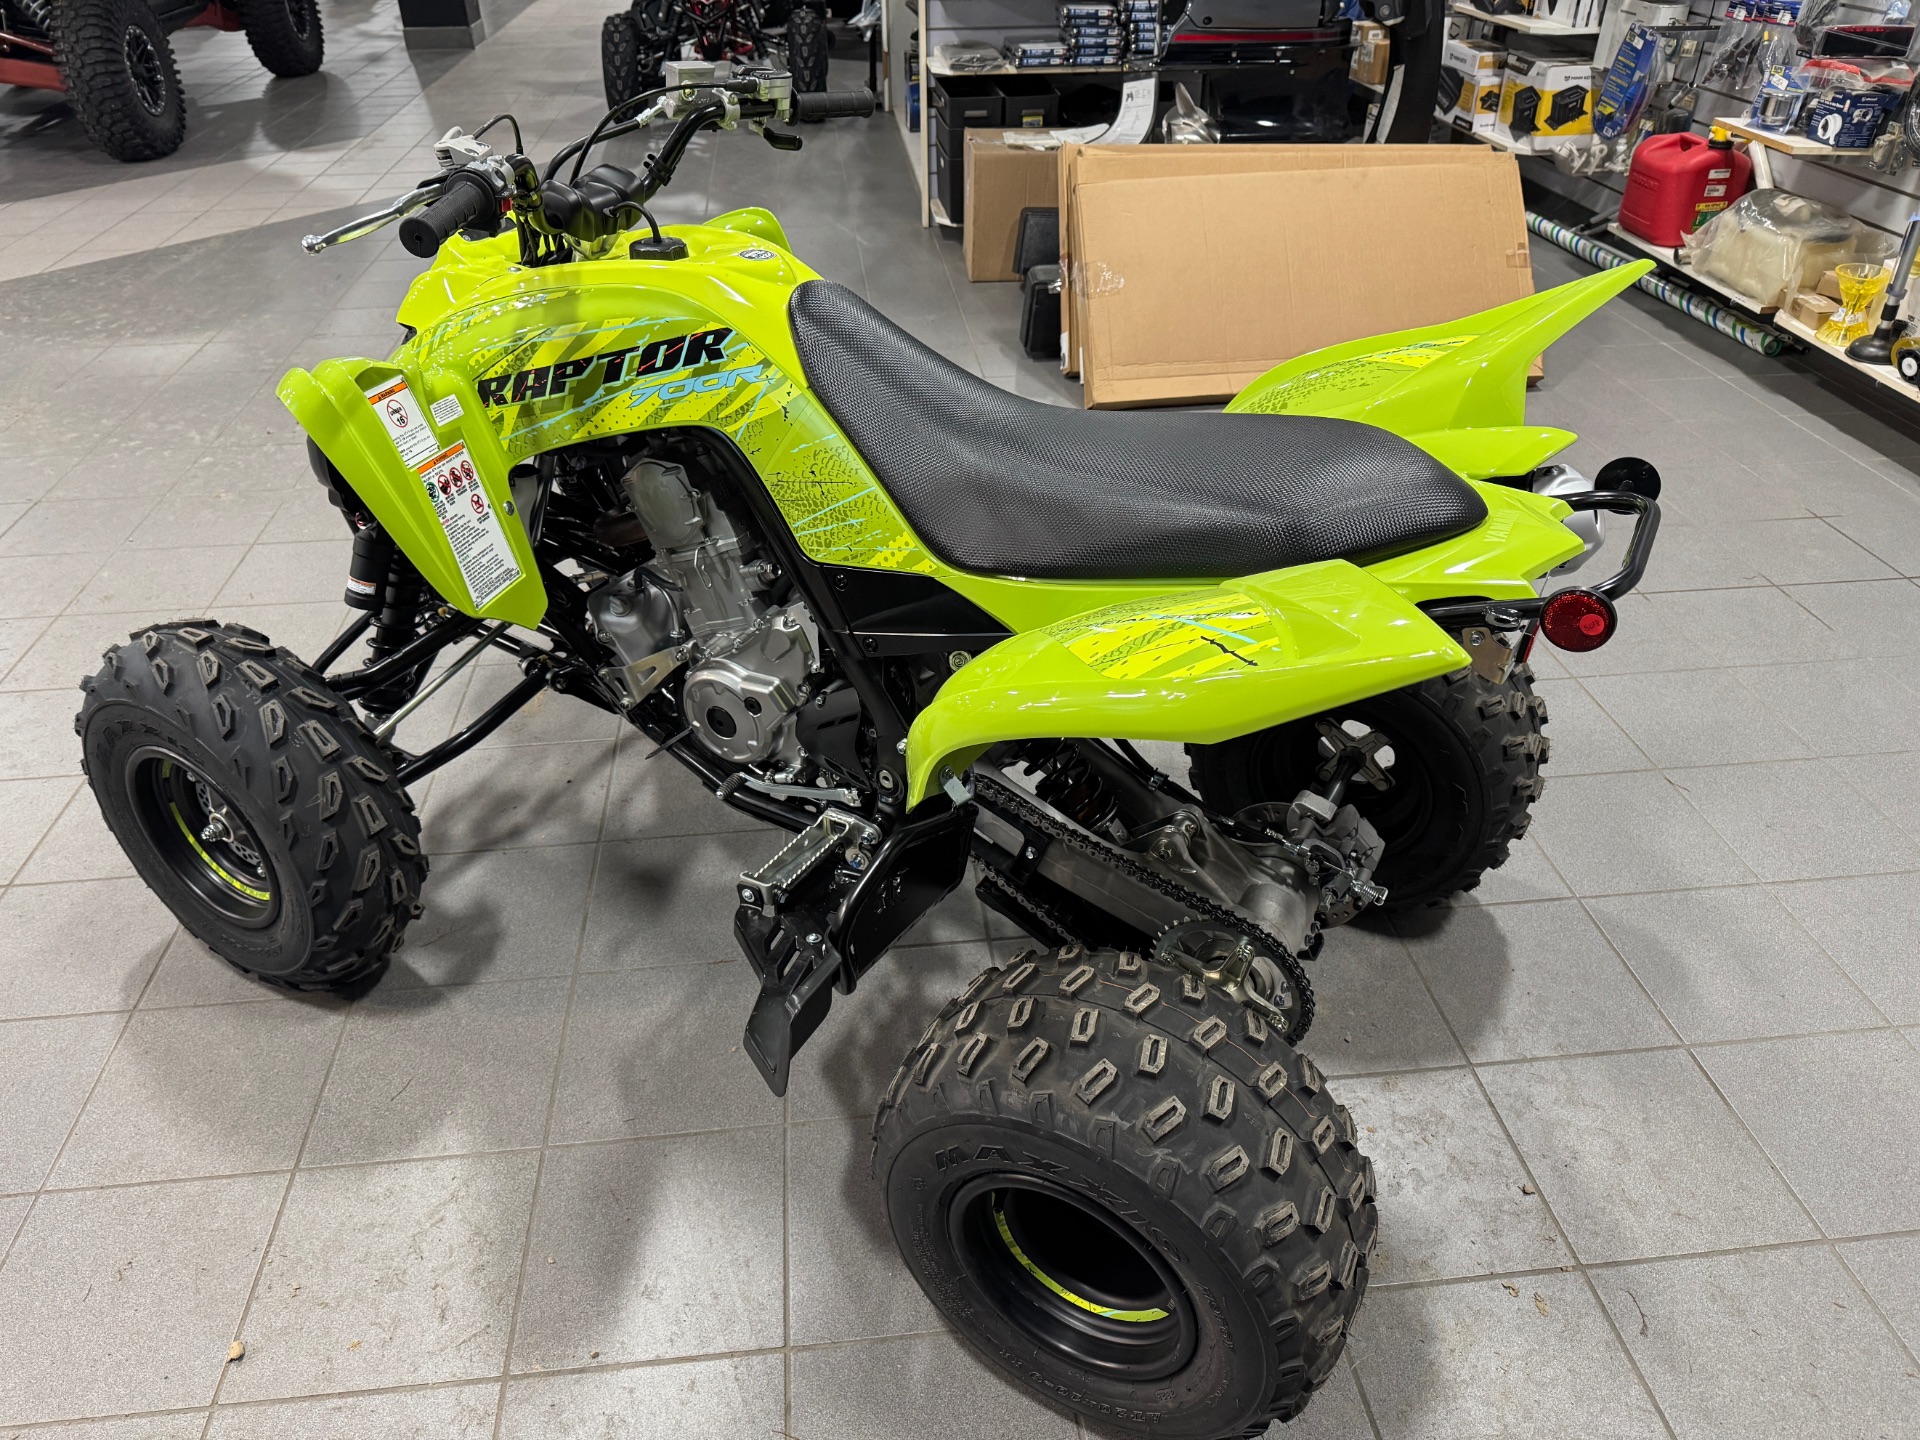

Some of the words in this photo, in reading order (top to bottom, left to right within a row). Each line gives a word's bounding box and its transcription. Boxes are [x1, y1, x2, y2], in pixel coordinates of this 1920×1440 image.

[477, 327, 738, 410] RAPTOR
[625, 364, 776, 409] 700R
[396, 416, 406, 426] 16
[934, 1144, 1181, 1263] MAXXIS
